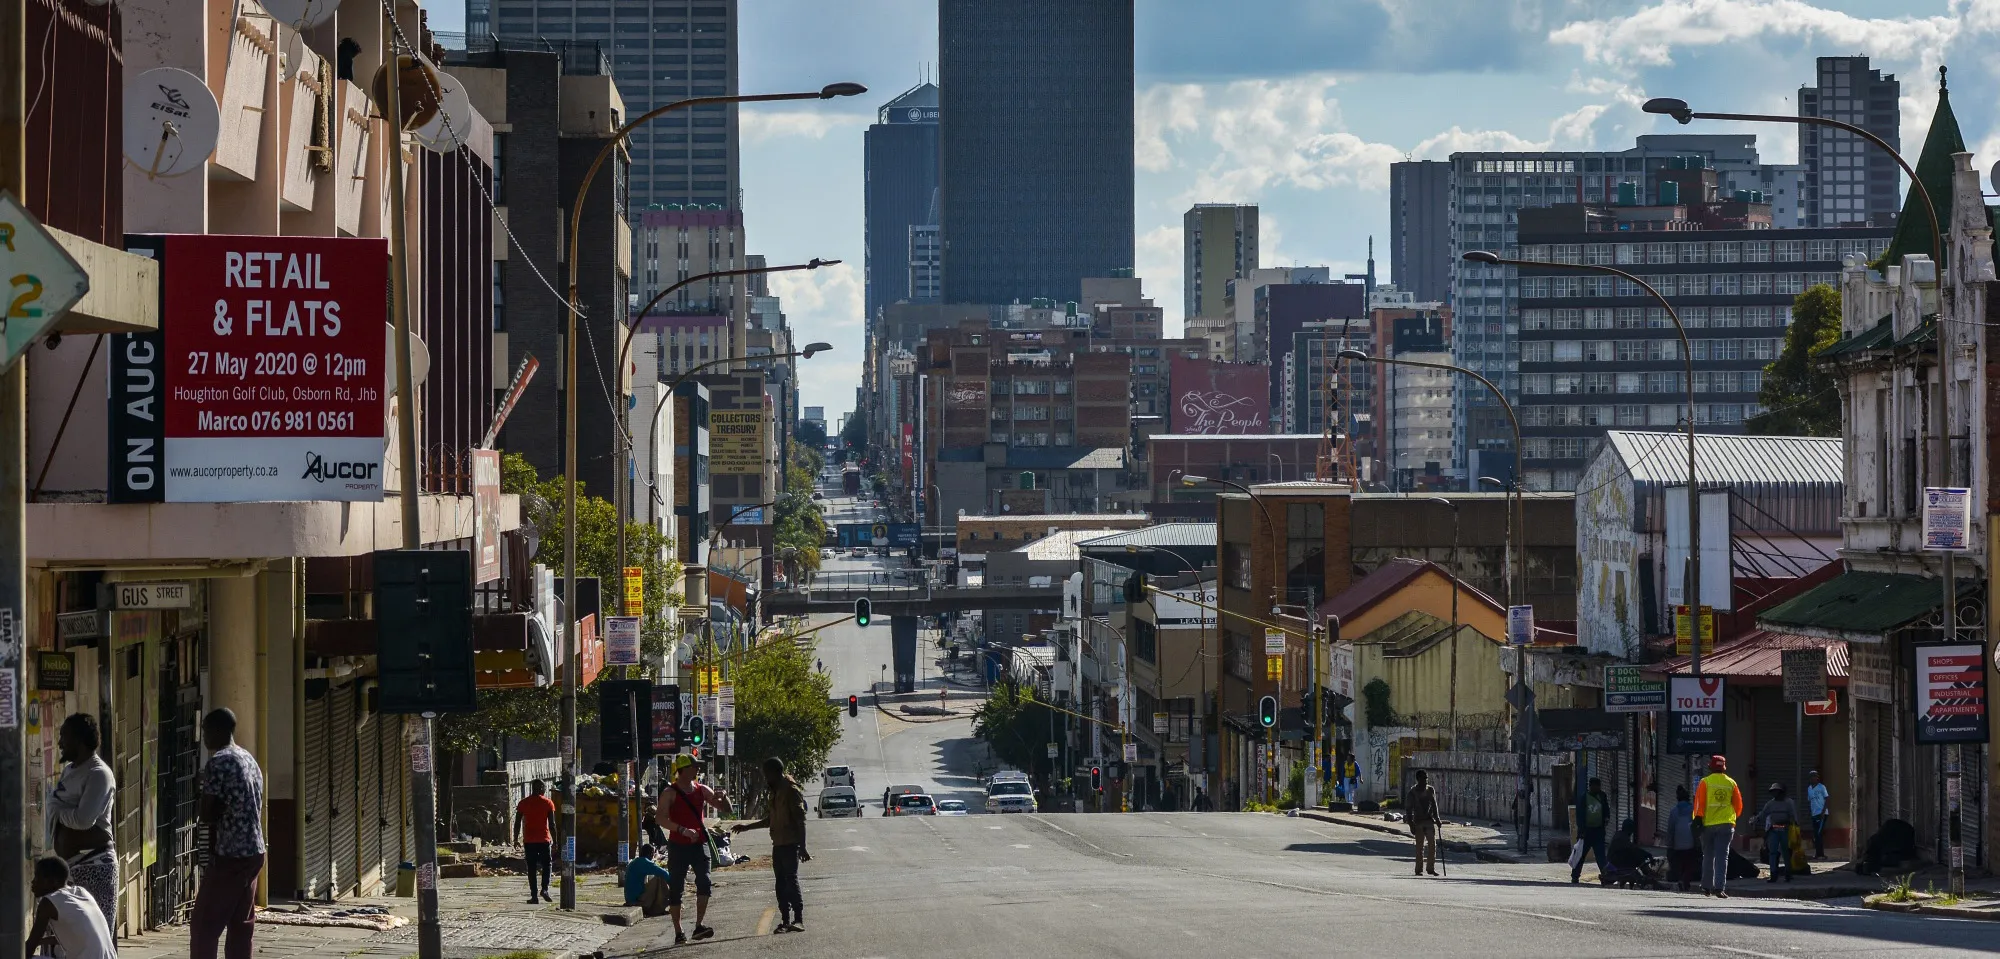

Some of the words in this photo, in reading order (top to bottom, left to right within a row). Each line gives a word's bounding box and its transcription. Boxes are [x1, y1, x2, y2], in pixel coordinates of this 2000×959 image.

[922, 111, 940, 119] LIBE
[225, 252, 330, 289] RETAIL
[213, 299, 233, 336] &
[246, 300, 342, 337] FLATS
[188, 352, 209, 375] 27
[215, 352, 248, 380] May
[254, 352, 297, 375] 2020
[302, 353, 318, 374] @
[324, 353, 366, 381] 12pm
[174, 386, 229, 403] Houghton
[233, 386, 256, 401] Golf
[259, 387, 289, 402] Club,
[292, 387, 331, 401] Osborn
[335, 387, 353, 403] Rd,
[357, 387, 377, 401] Jhb
[198, 410, 248, 431] Marco
[251, 411, 281, 431] 076
[284, 411, 312, 431] 981
[317, 411, 354, 431] 0561
[711, 413, 761, 423] COLLECTORS
[1217, 409, 1262, 434] People
[716, 424, 757, 434] TREASURY
[127, 438, 154, 490] ON
[169, 464, 278, 480] www.aucorproperty.co.za
[302, 453, 378, 480] Aucor
[122, 587, 148, 606] GUS
[156, 586, 183, 599] STREET
[1192, 591, 1218, 602] Blo
[44, 658, 68, 670] hello
[0, 671, 14, 725] ABORTION
[652, 701, 675, 710] ARRIORS
[1677, 697, 1694, 708] TO
[1696, 697, 1717, 708] LET
[1681, 714, 1713, 726] NOW
